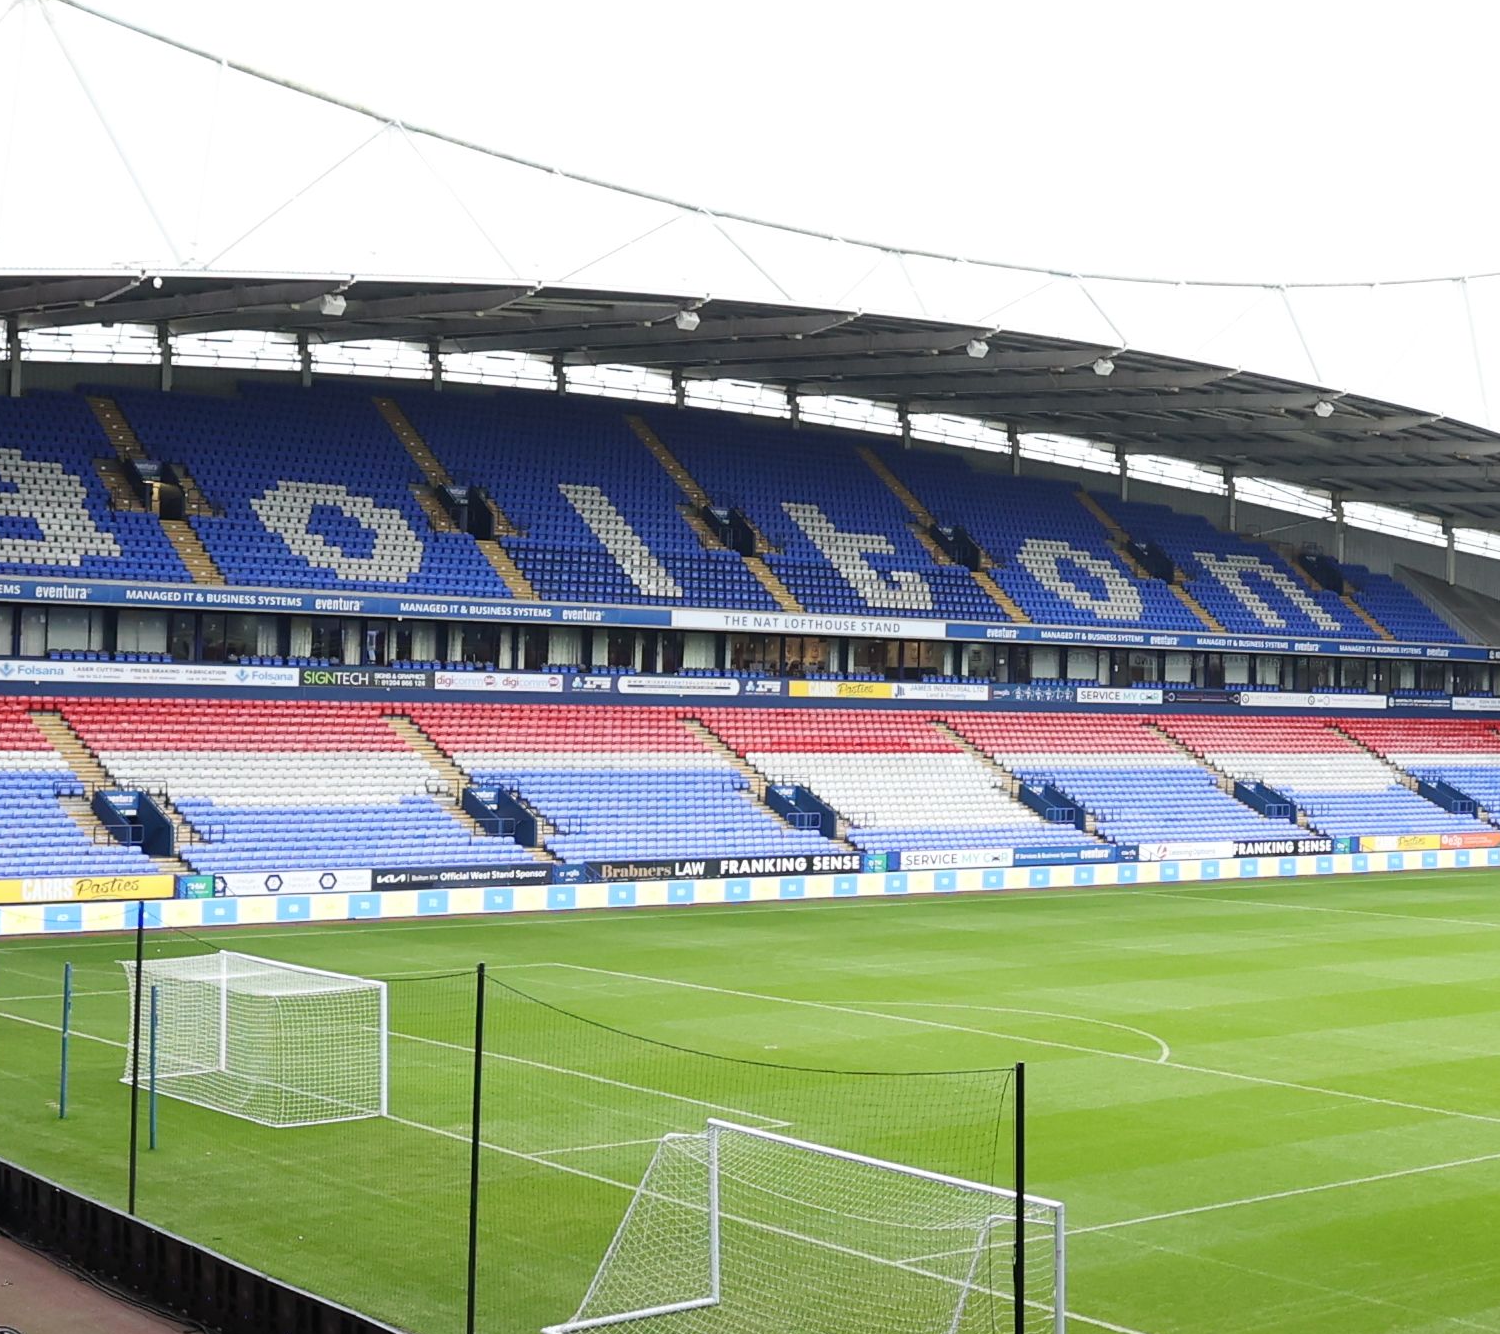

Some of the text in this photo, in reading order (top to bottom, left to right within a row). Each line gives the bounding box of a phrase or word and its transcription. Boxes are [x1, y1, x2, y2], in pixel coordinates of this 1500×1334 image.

[35, 584, 88, 600] eventura
[126, 590, 302, 607] MANAGED IT & BUSINESS SYSTEMS
[315, 596, 361, 612] eventura
[400, 602, 552, 618] MANAGED IT & BUSINESS SYSTEMS
[562, 607, 602, 622] eventura
[724, 616, 901, 633] THE NAT LOFTHOUSE STAND
[986, 628, 1017, 639] eventura
[18, 664, 64, 676] Folsana
[252, 670, 294, 682] Folsana
[303, 670, 369, 686] SIGNTECH
[436, 675, 484, 688] digicomm
[502, 676, 547, 689] digicomm
[838, 682, 874, 697] Pasties
[1081, 690, 1141, 701] SERVICE MY
[1232, 837, 1332, 856] FRANKING SENSE
[720, 854, 860, 875] FRANKING SENSE
[905, 853, 982, 866] SERVICE MY
[440, 868, 547, 881] Official West Stand Sponsor
[601, 863, 671, 879] Brabners
[674, 861, 706, 876] LAW
[76, 877, 140, 896] Pasties
